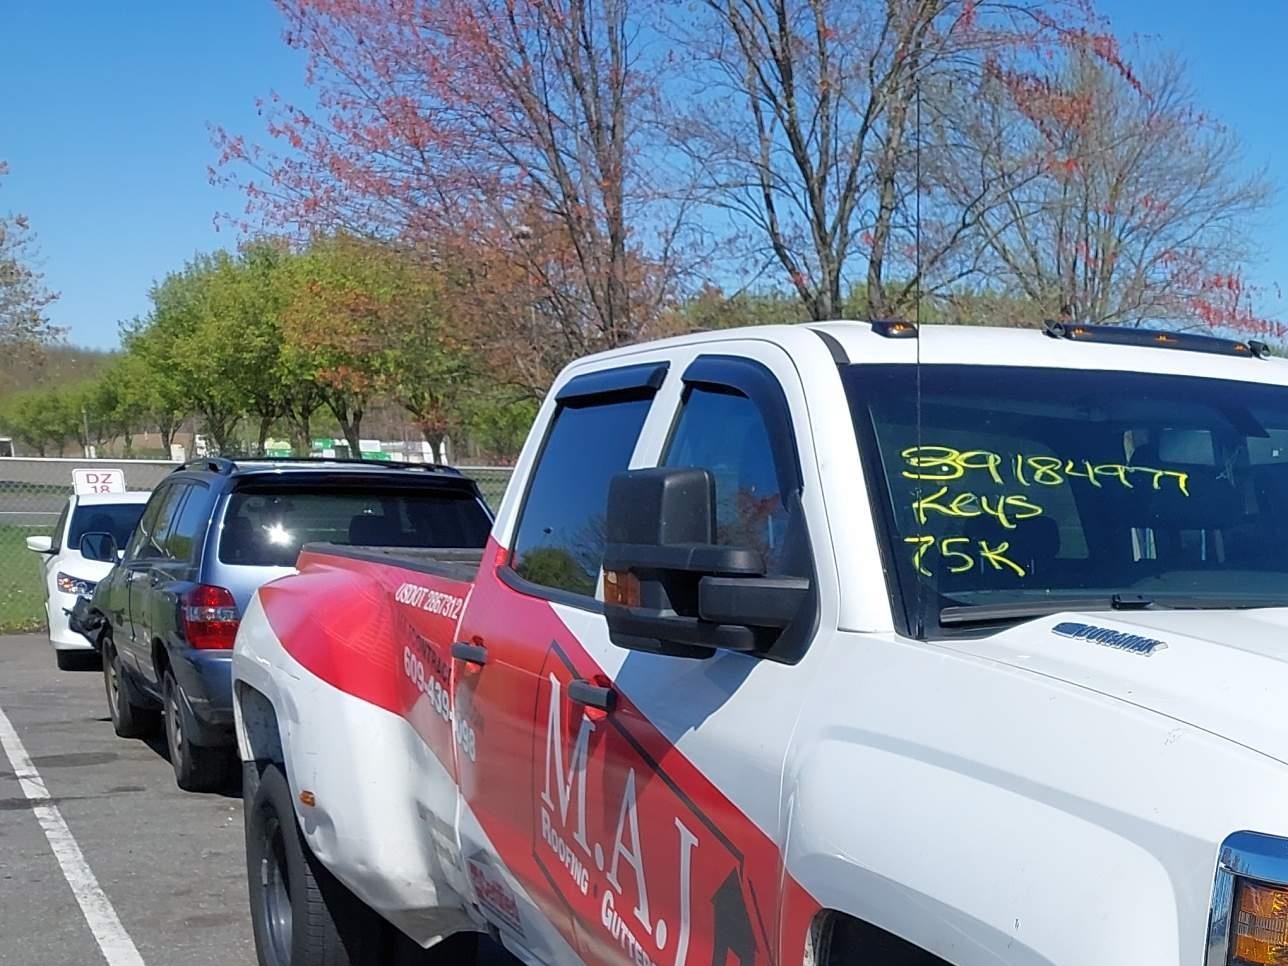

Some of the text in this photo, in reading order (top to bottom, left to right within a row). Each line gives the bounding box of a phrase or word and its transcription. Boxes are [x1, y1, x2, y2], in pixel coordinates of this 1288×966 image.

[86, 473, 113, 484] DZ
[902, 446, 1190, 496] 39184977
[904, 537, 1026, 577] 75K
[541, 806, 589, 896] ROOFING
